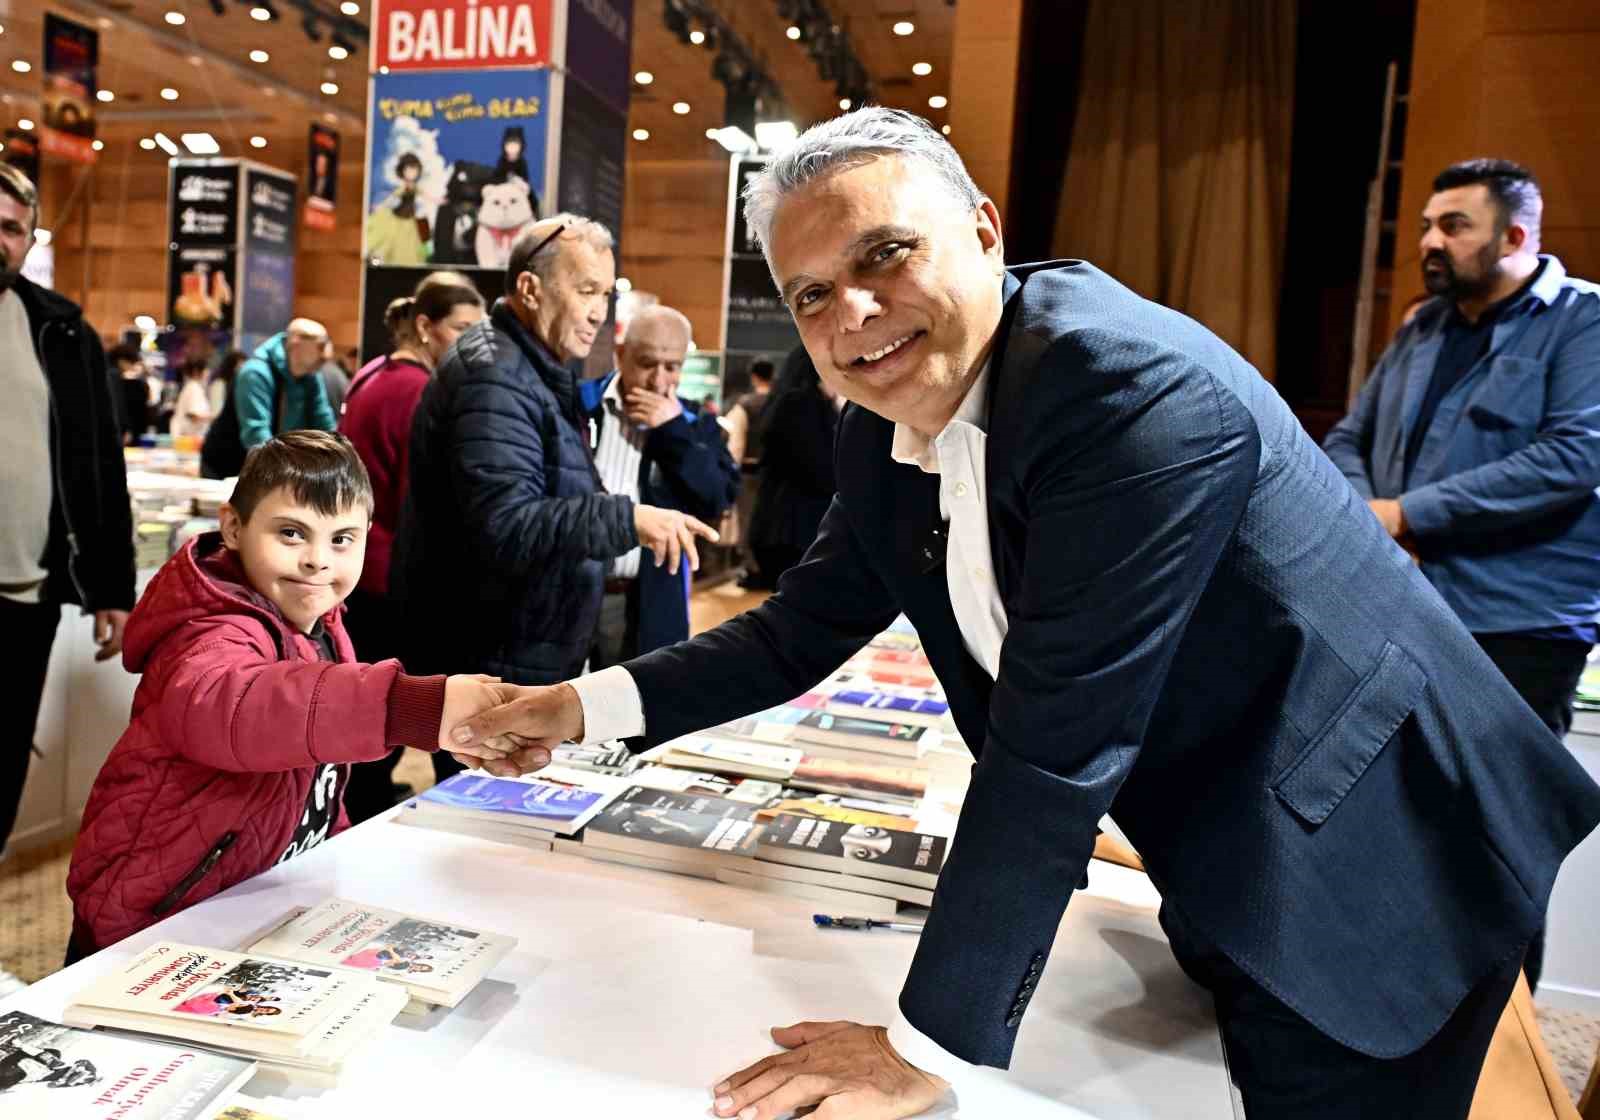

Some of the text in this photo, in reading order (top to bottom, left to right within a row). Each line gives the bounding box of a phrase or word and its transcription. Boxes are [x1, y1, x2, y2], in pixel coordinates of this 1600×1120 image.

[388, 0, 537, 61] BALİNA
[127, 955, 192, 996] CUMHURİYET
[160, 971, 212, 1001] Yüzyılda
[91, 1067, 149, 1105] Olmak
[105, 1052, 196, 1120] Cumhuriye
